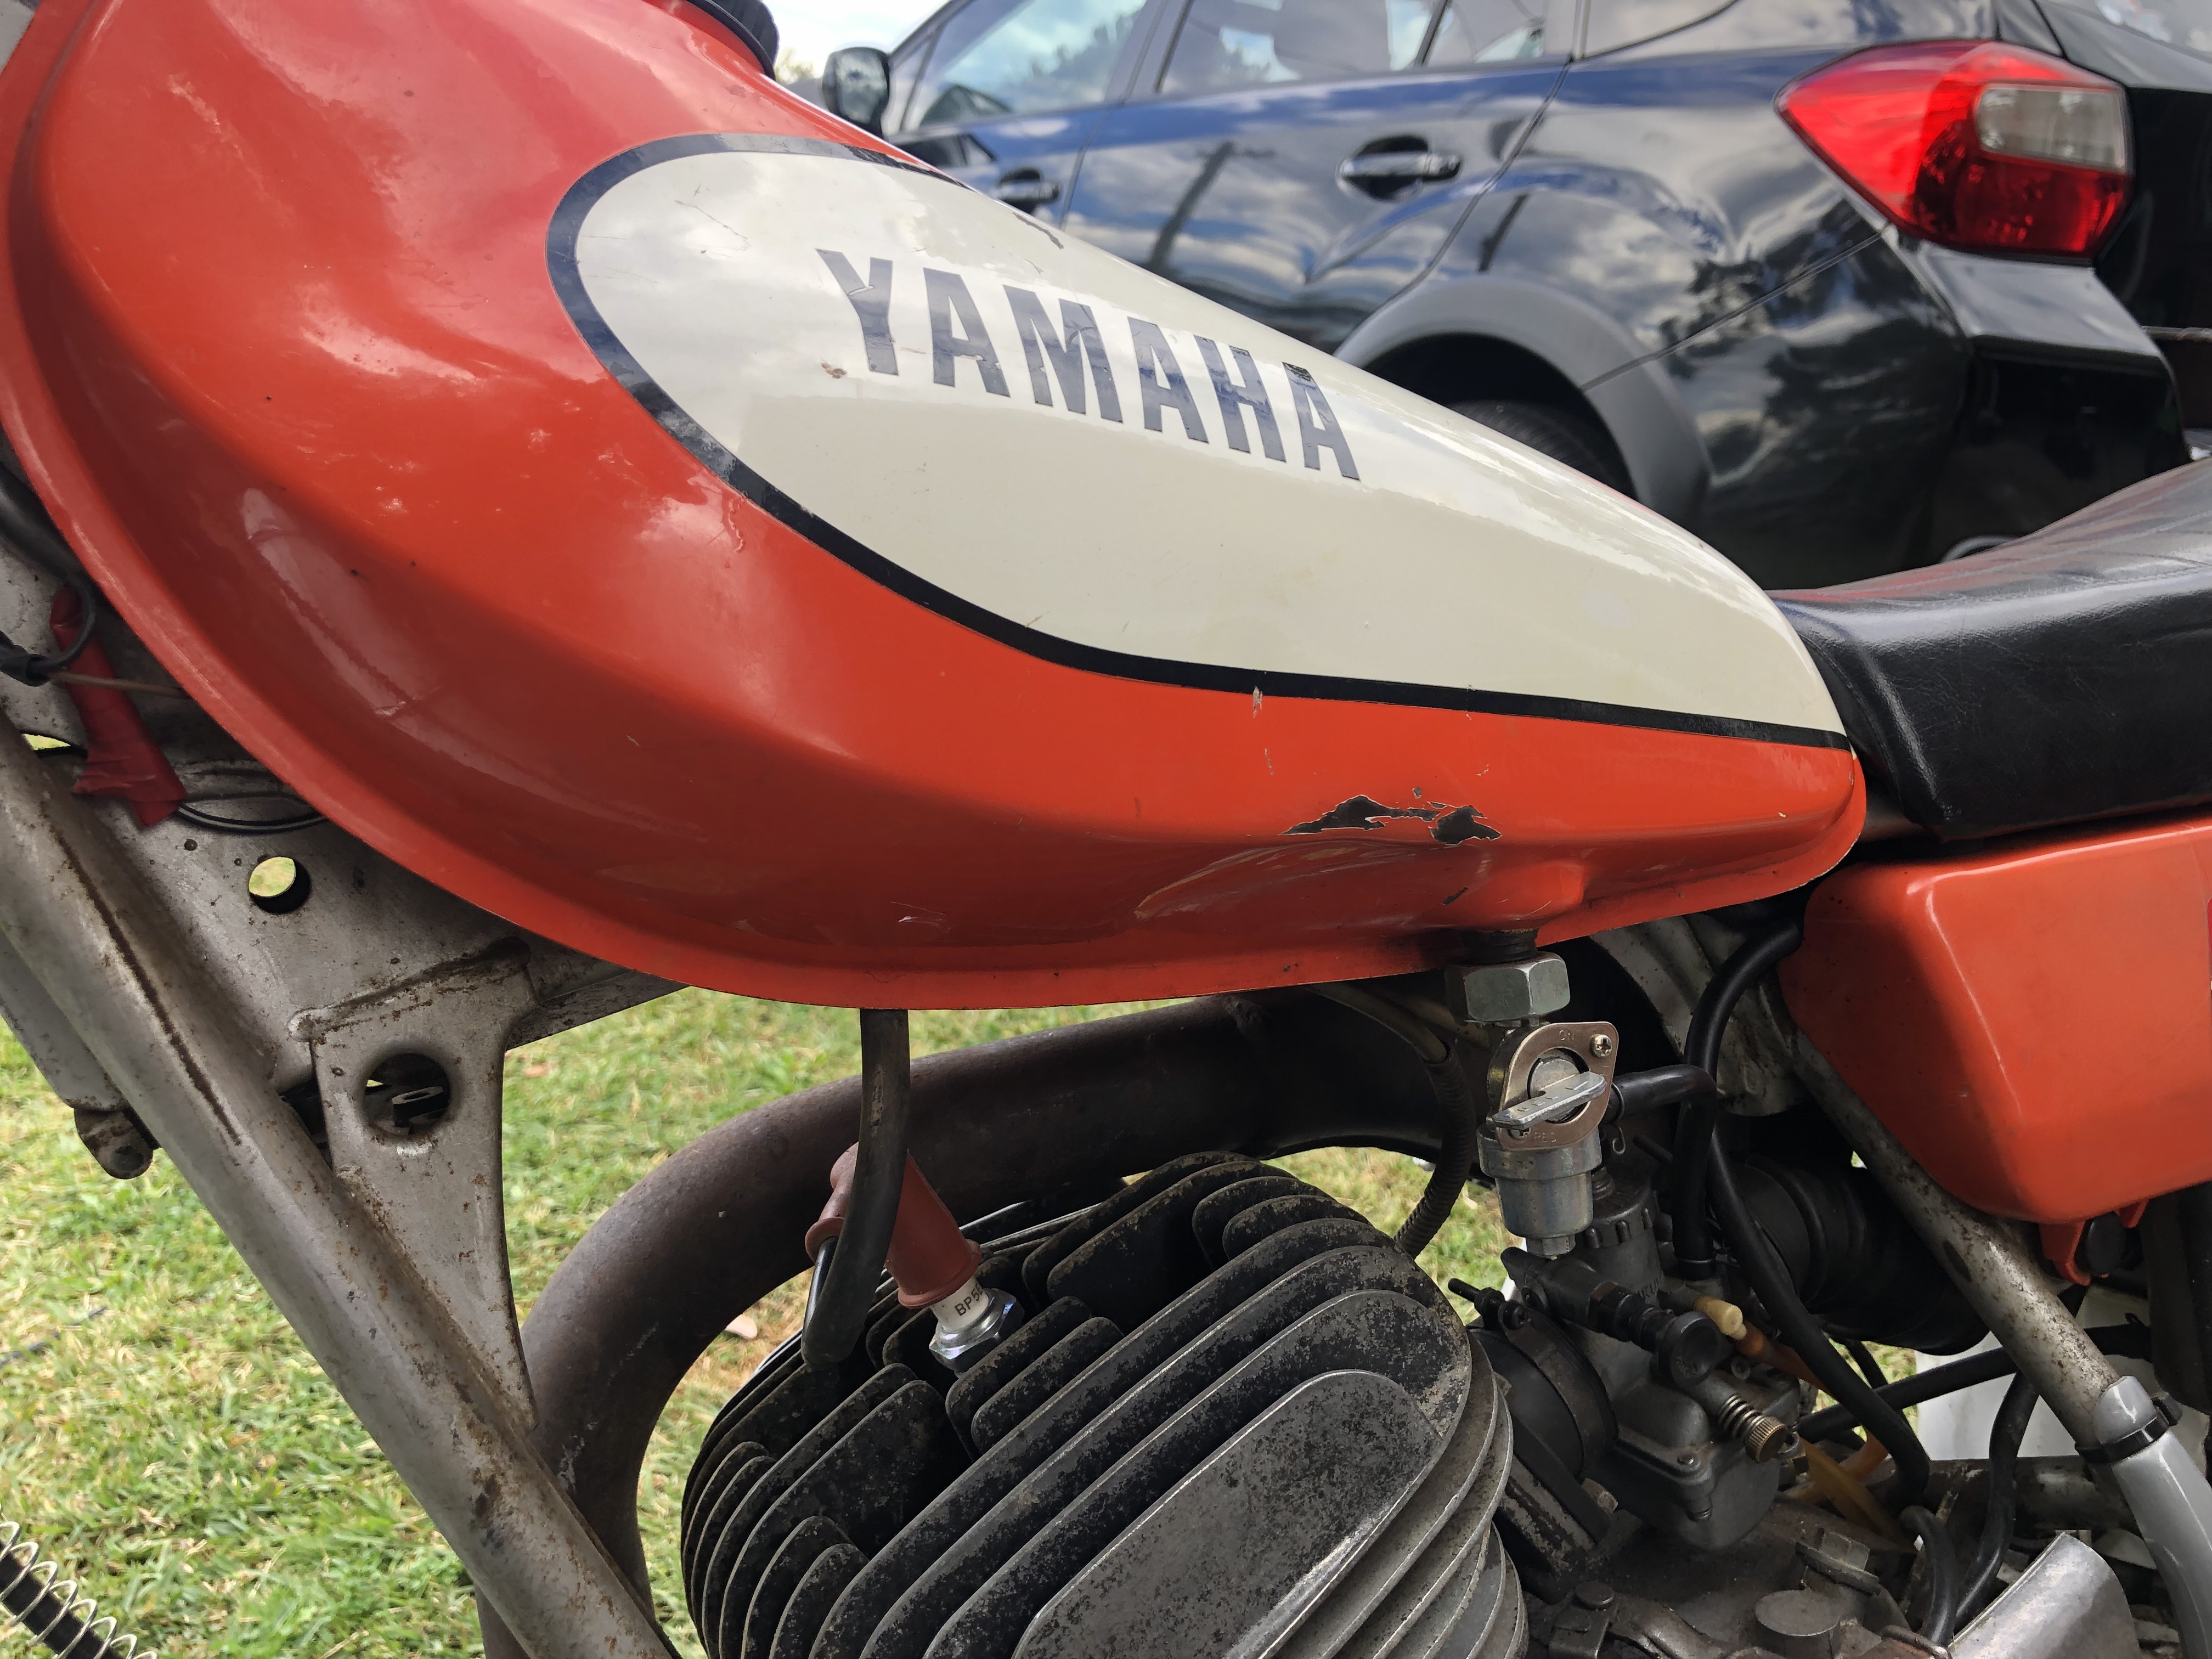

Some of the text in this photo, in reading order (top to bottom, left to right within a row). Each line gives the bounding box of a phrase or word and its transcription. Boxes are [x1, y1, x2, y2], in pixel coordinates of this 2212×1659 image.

[815, 249, 1361, 481] YAMAHA
[1559, 1030, 1575, 1040] ON
[1534, 1132, 1556, 1143] RES
